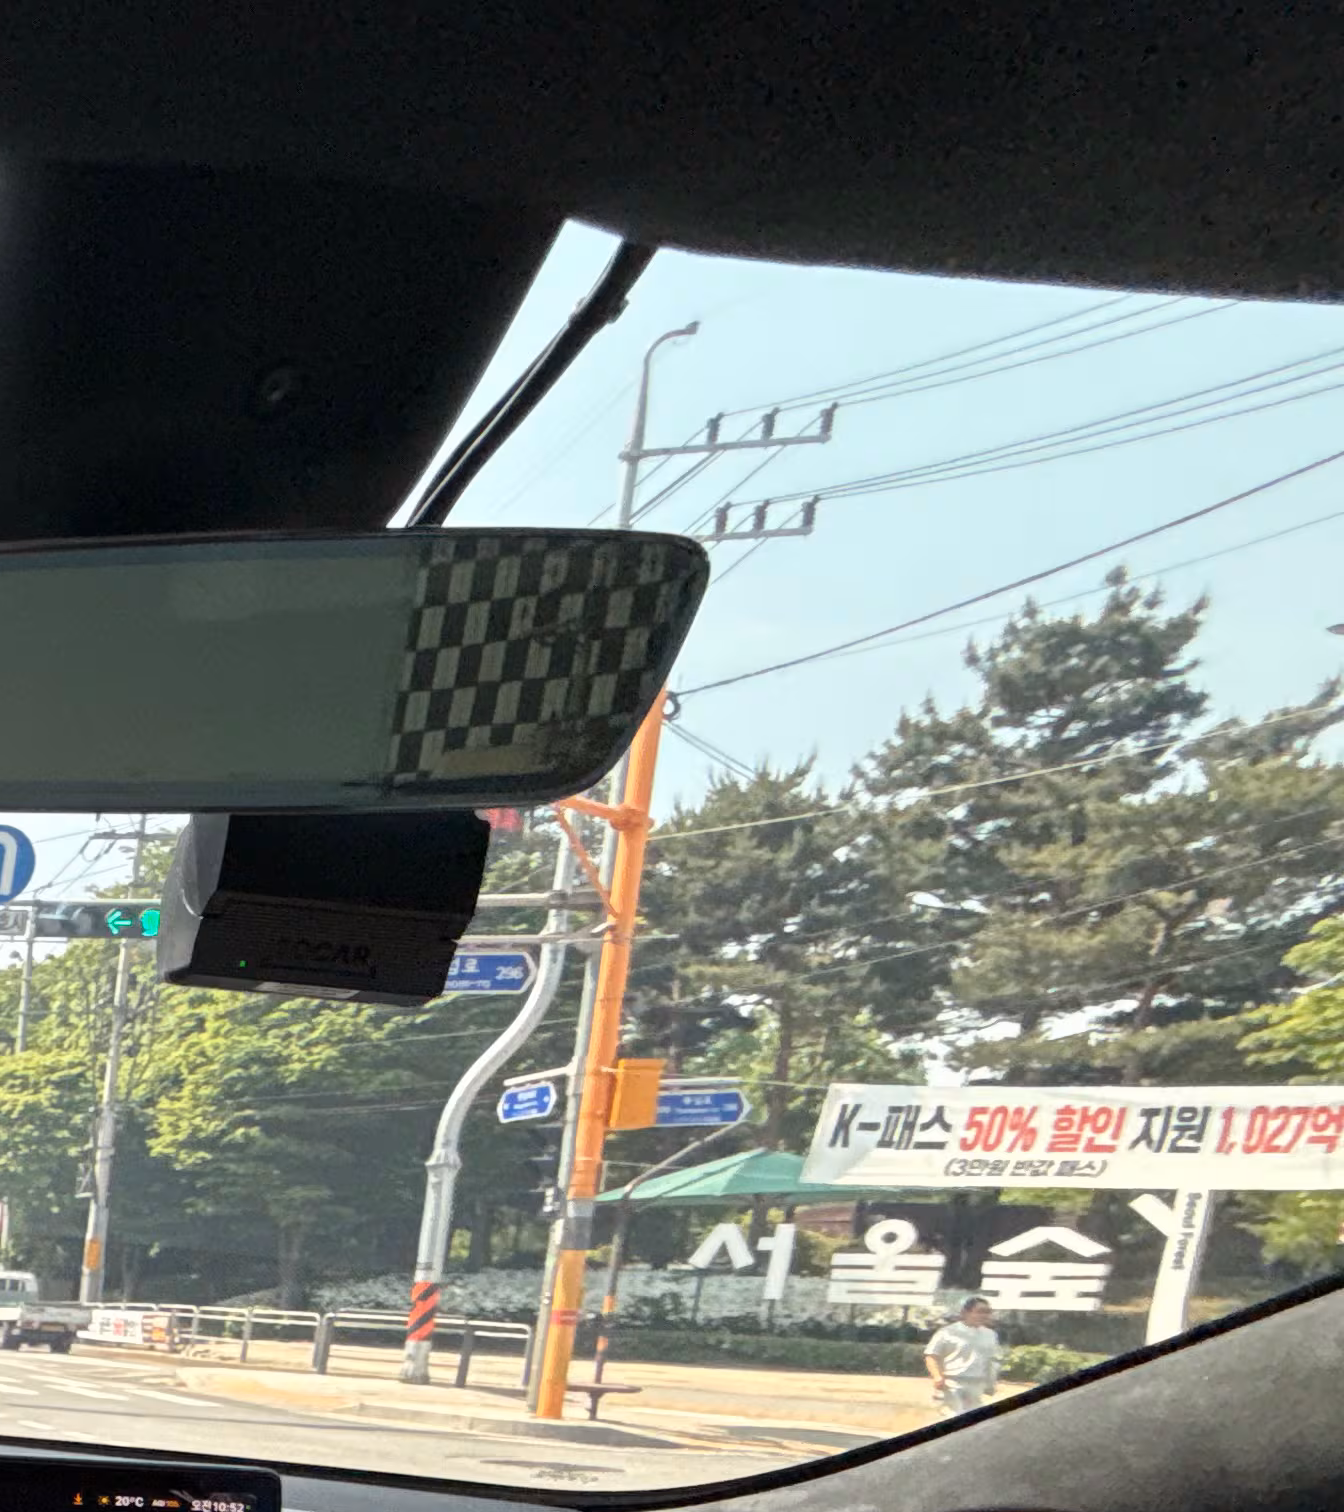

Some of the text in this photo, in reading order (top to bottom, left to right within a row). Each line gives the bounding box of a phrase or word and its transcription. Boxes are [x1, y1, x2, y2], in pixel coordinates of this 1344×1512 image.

[828, 1103, 953, 1152] K-패스
[959, 1103, 1039, 1152] 50%
[1046, 1105, 1127, 1153] 할인
[1129, 1105, 1211, 1154] 지원
[944, 1157, 1006, 1177] (3만원
[1008, 1158, 1052, 1178] 반값
[689, 1218, 1112, 1312] 서울숲
